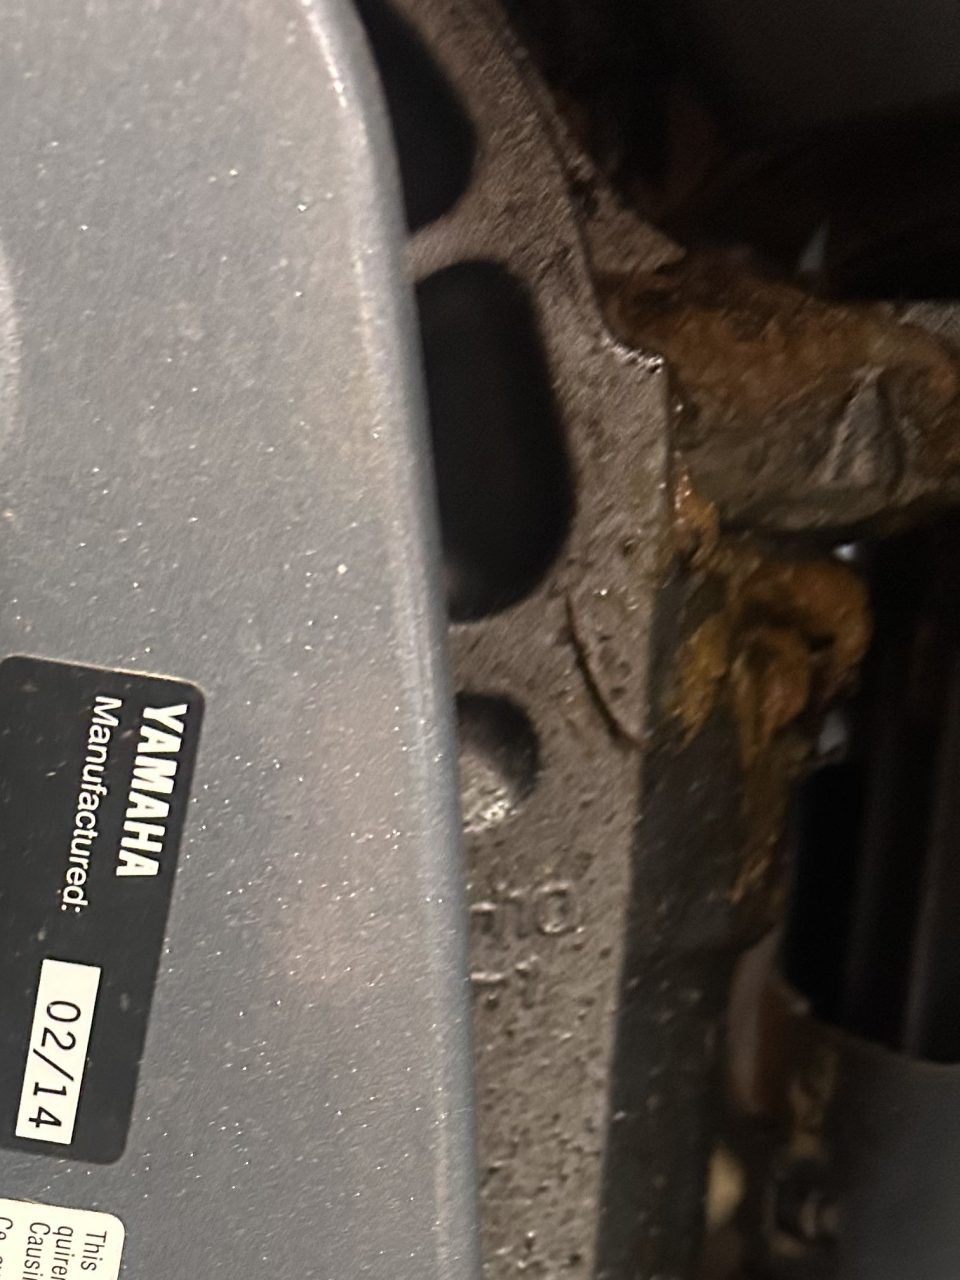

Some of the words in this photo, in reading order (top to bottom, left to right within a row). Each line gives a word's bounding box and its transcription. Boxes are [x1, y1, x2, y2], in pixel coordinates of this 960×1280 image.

[60, 695, 123, 914] Manufactured:
[115, 703, 188, 877] YAMAHA
[28, 1000, 82, 1129] 02/14
[80, 1231, 107, 1271] This
